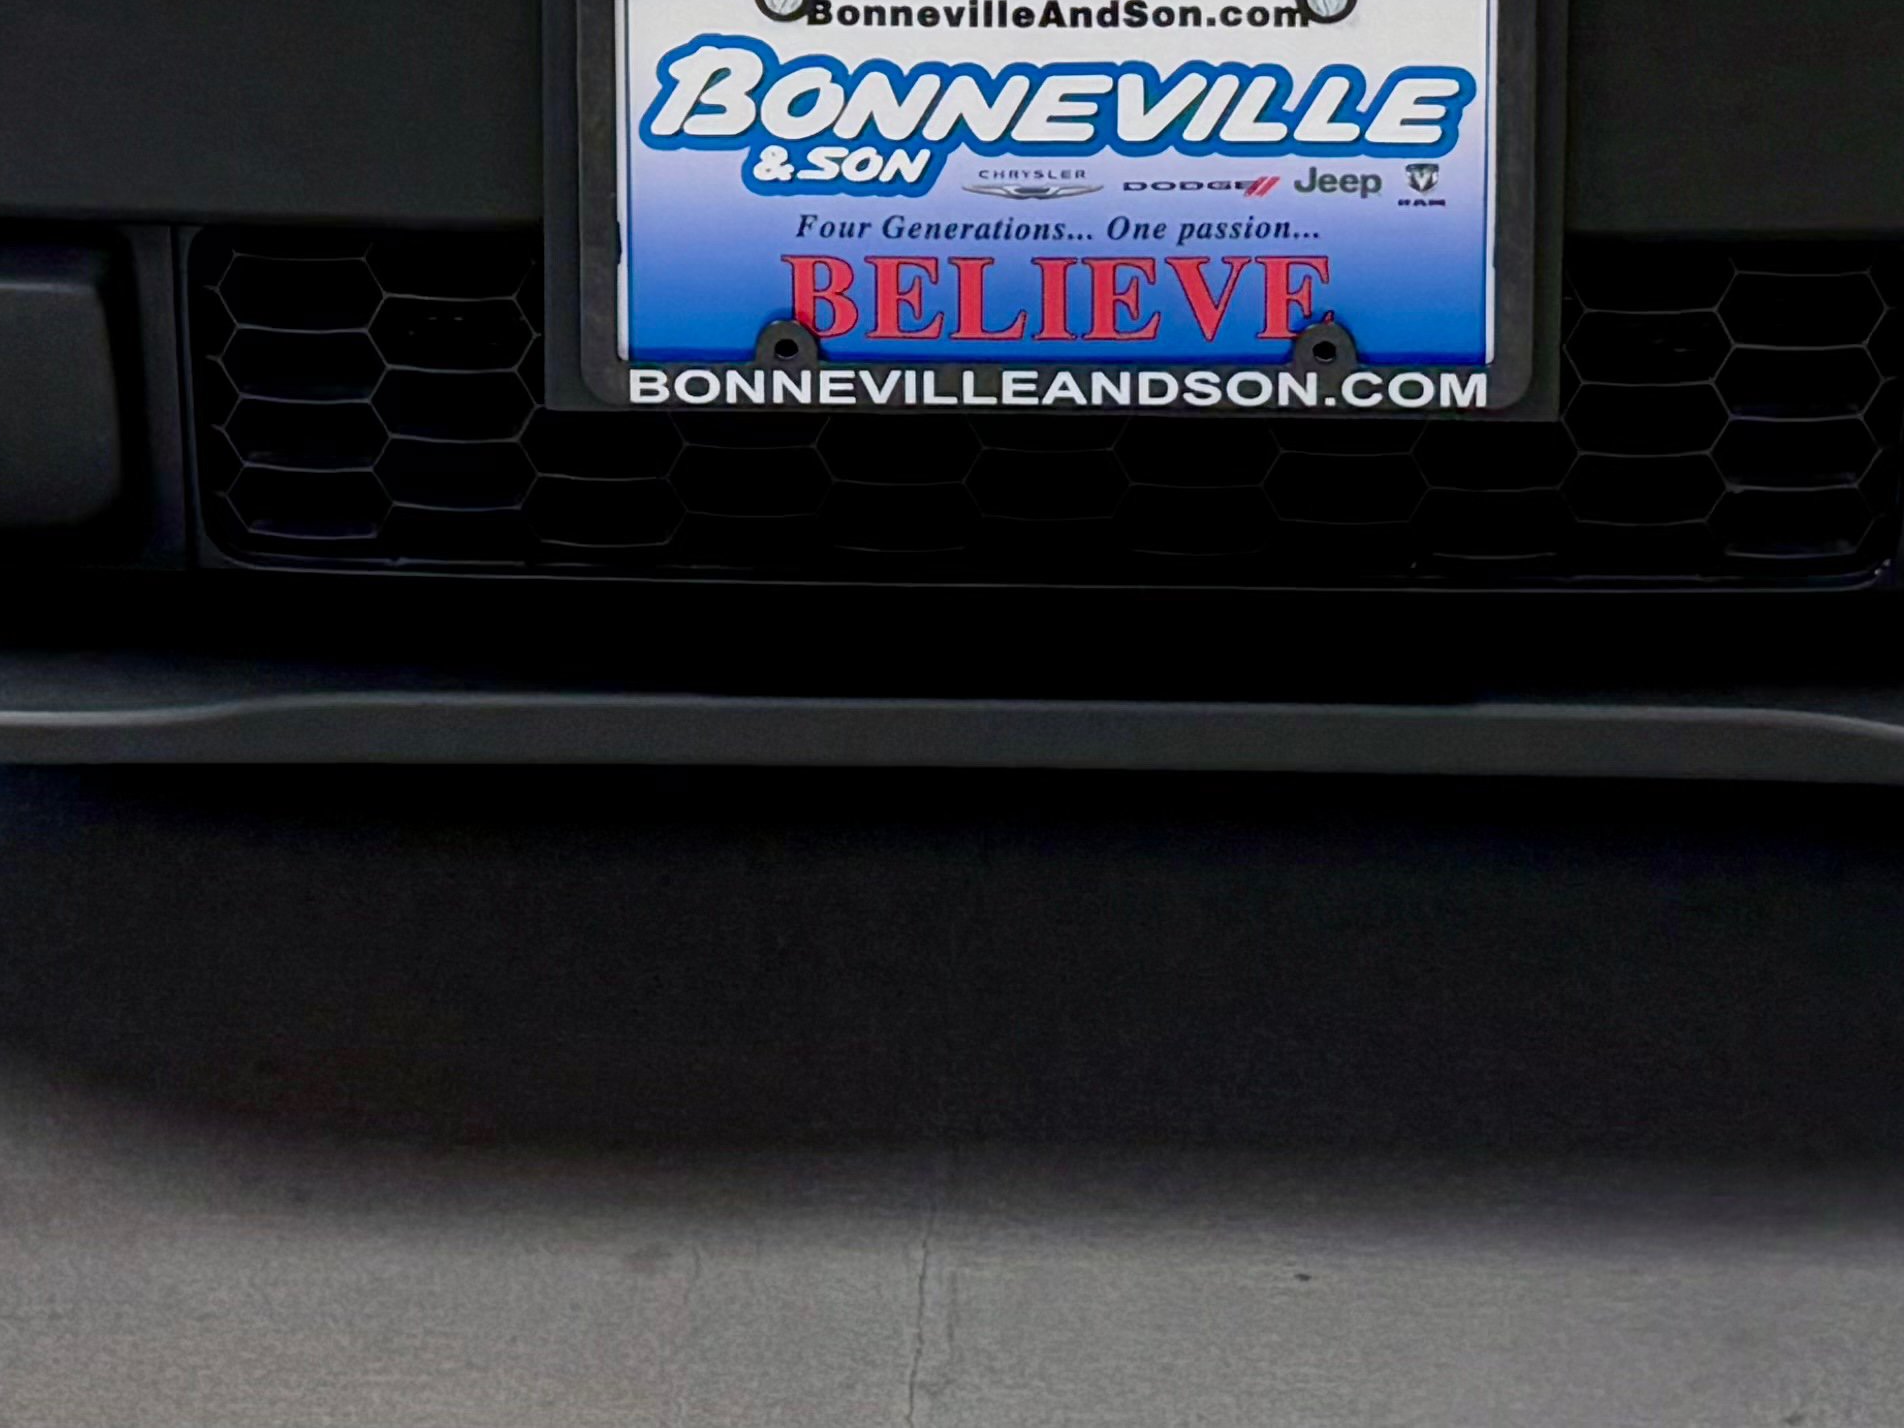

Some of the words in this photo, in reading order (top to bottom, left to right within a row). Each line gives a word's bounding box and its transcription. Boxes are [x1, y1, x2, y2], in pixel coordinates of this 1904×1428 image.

[650, 46, 1460, 144] BONNEVILLE
[978, 168, 1087, 180] CHRYSLER
[1294, 166, 1383, 199] Jeep
[796, 214, 872, 240] Four
[882, 214, 1093, 240] Generations...
[1107, 215, 1166, 240] One
[1176, 216, 1320, 246] passion...
[780, 255, 1335, 342] BELIEVE
[629, 369, 1488, 408] BONNEVILLEANDSON.COM
